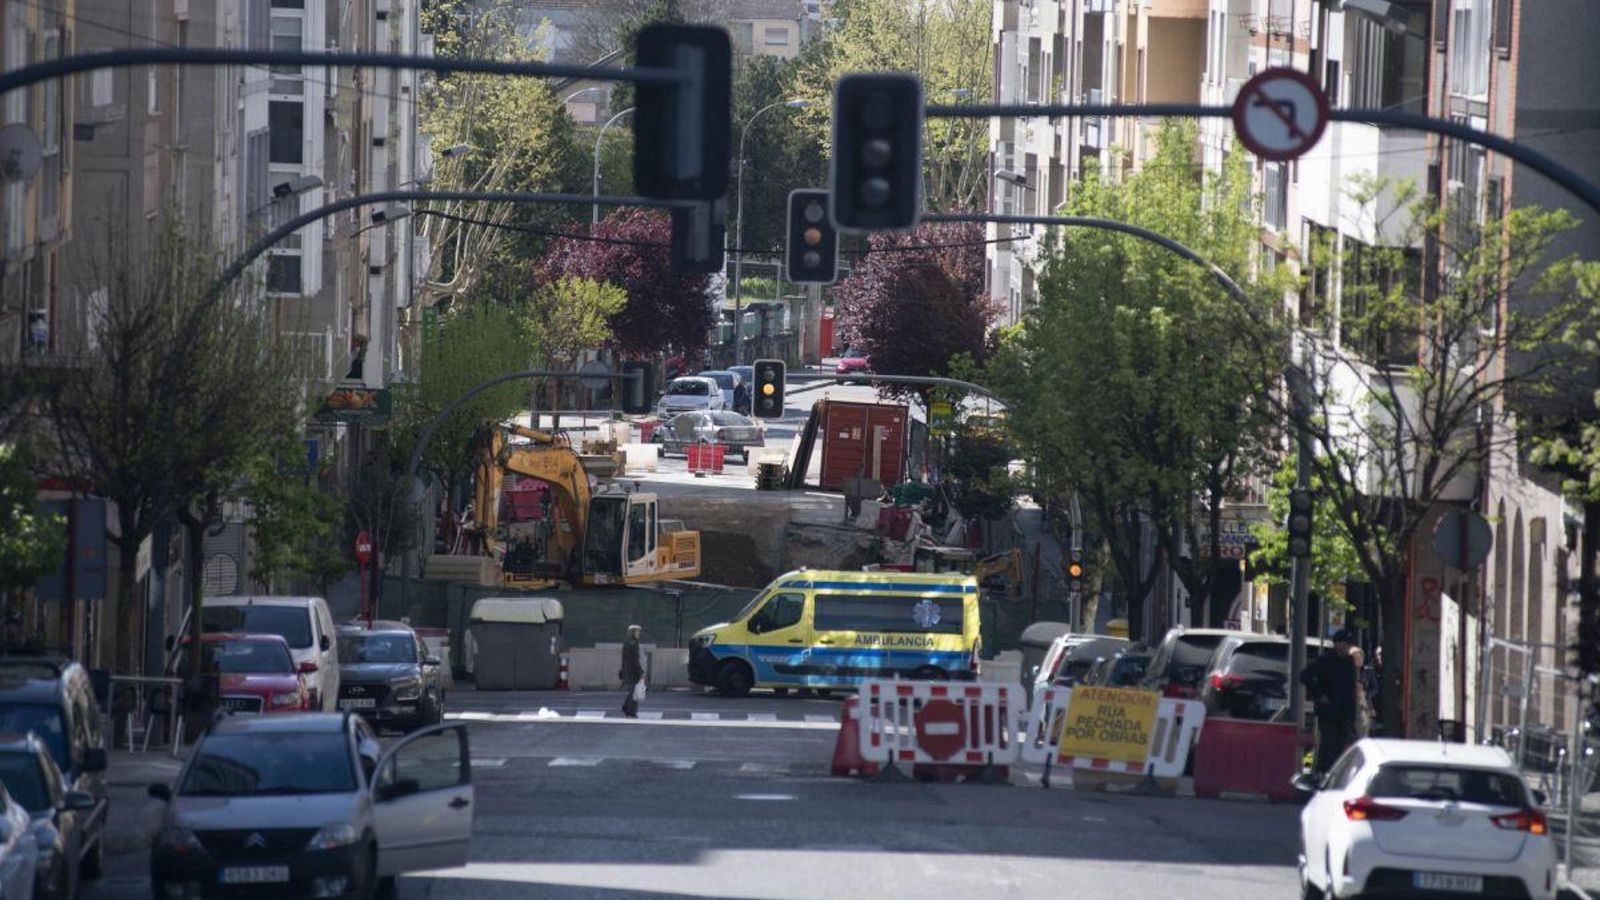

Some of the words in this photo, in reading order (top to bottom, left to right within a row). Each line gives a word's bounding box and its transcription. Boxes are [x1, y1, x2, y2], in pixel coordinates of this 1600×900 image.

[854, 634, 934, 647] AMBULANCIA
[1077, 716, 1142, 732] PECHADA
[1067, 727, 1095, 740] POR
[1099, 730, 1148, 746] OBRAS
